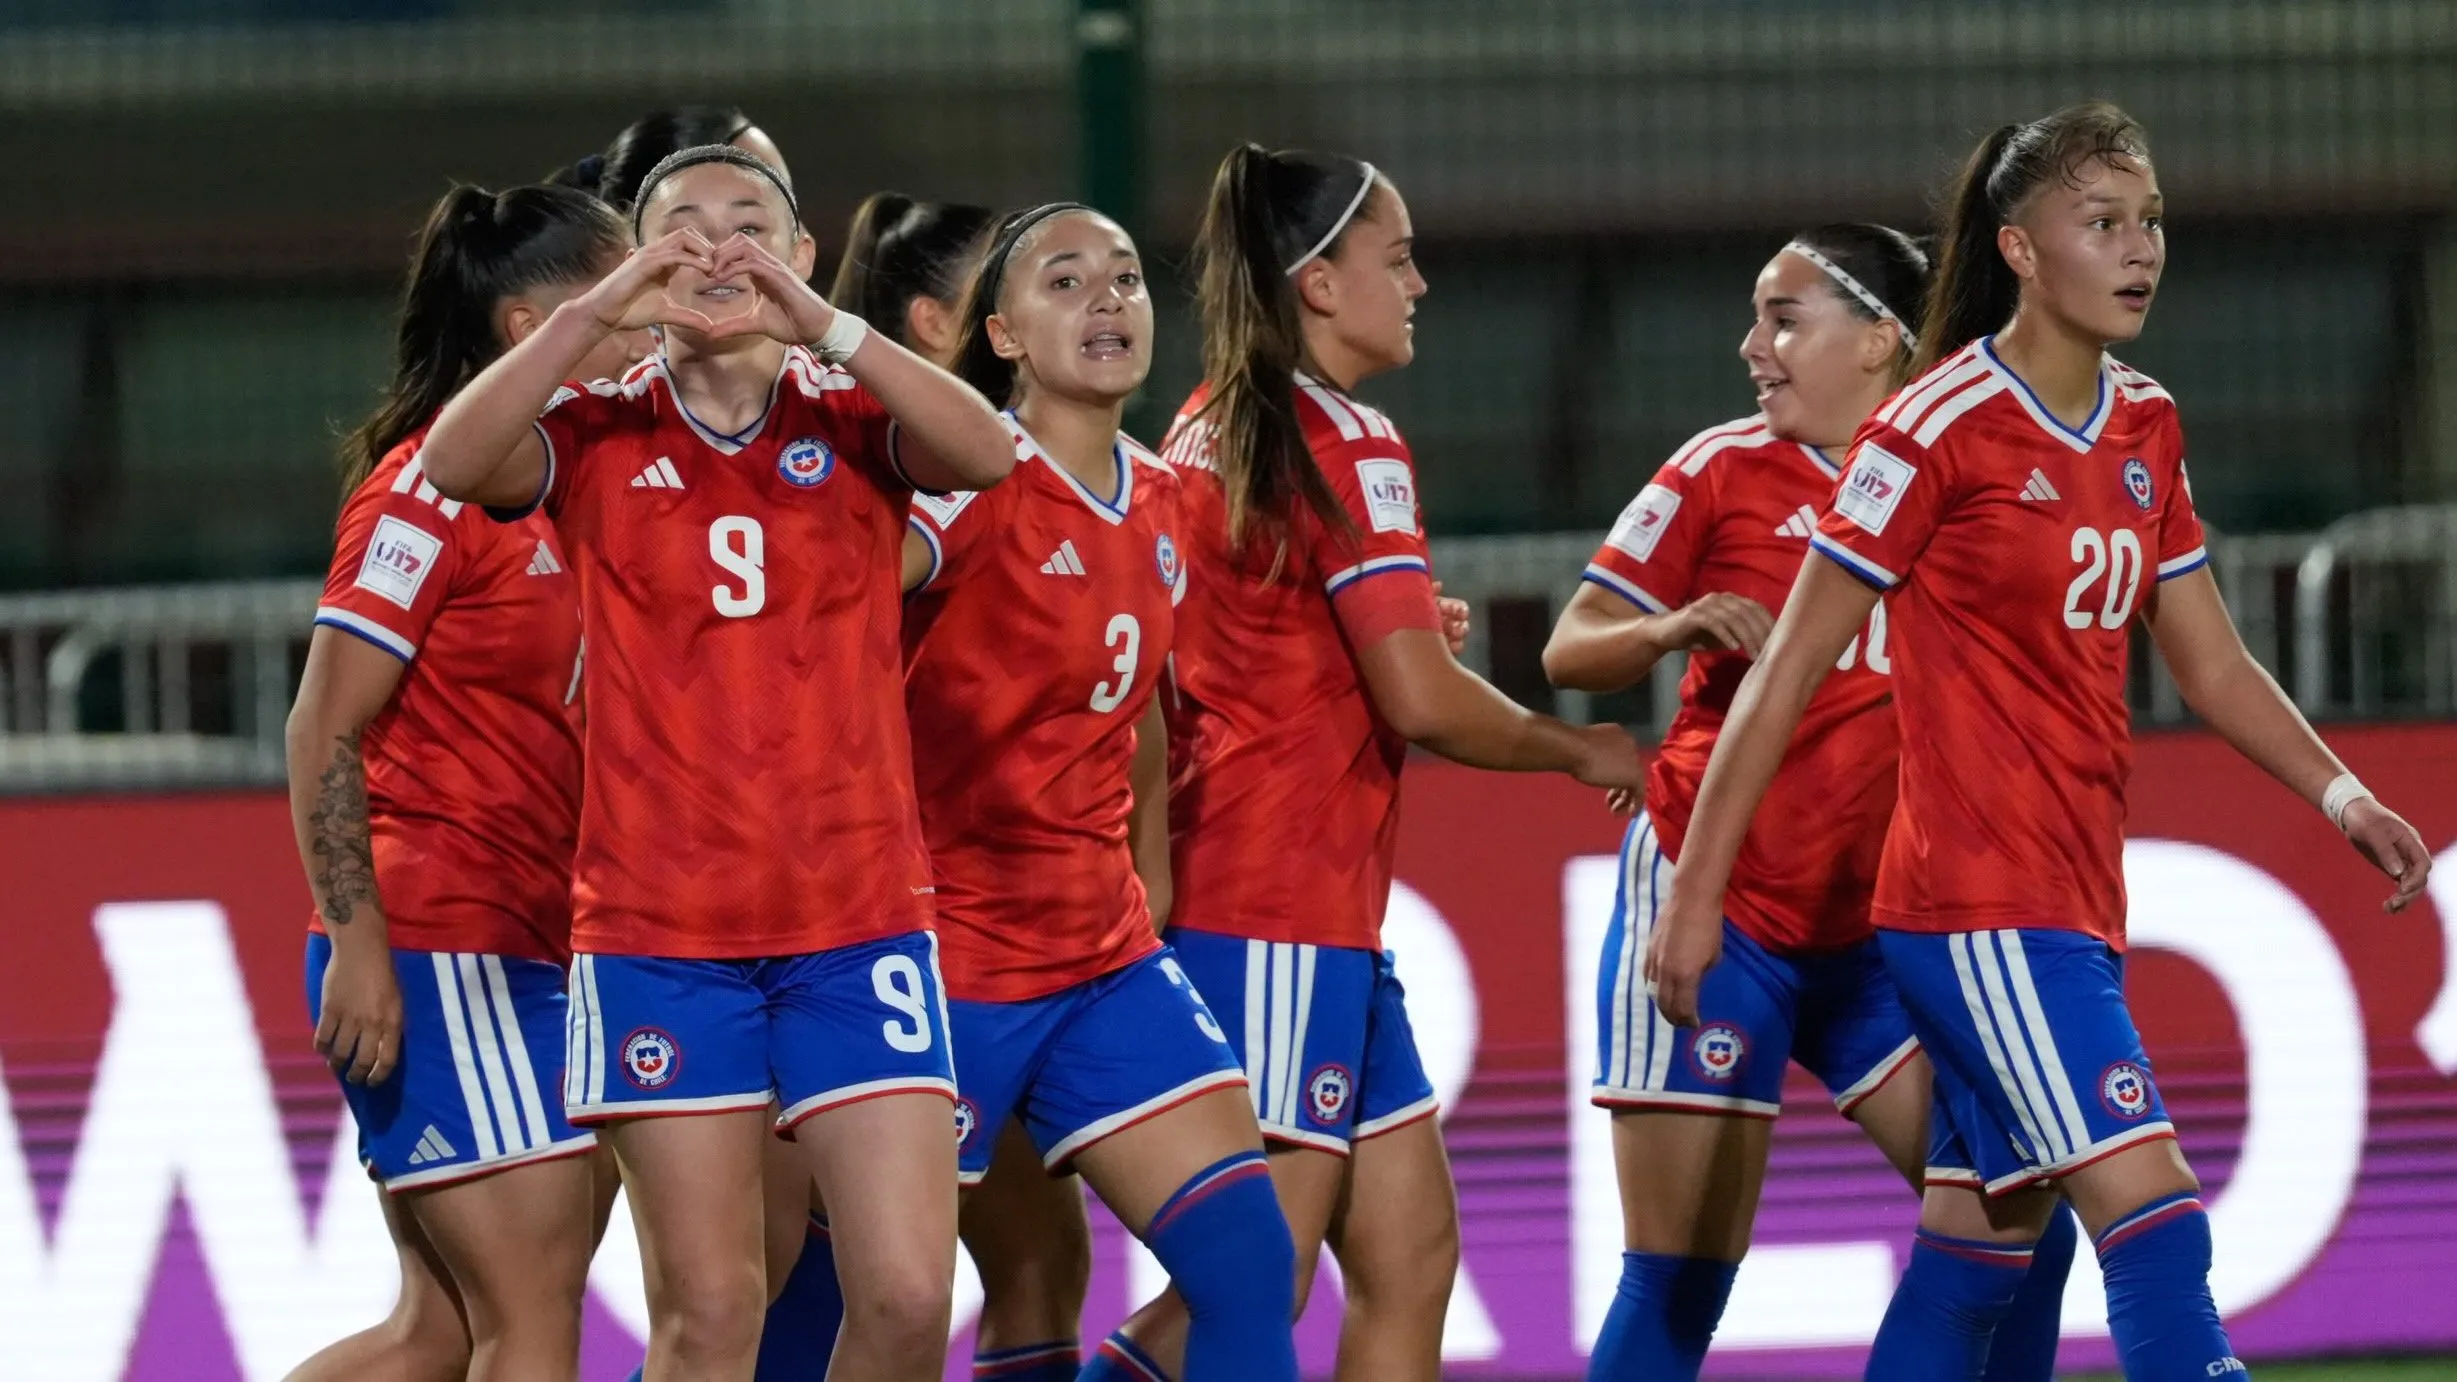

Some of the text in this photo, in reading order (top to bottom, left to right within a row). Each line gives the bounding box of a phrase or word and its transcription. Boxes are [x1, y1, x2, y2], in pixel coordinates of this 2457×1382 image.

[1373, 484, 1408, 502] U17
[1854, 467, 1895, 501] U17
[376, 541, 422, 575] U17
[709, 515, 766, 618] 9
[2063, 526, 2142, 630] 20
[1089, 613, 1141, 713] 3
[871, 954, 932, 1053] 9
